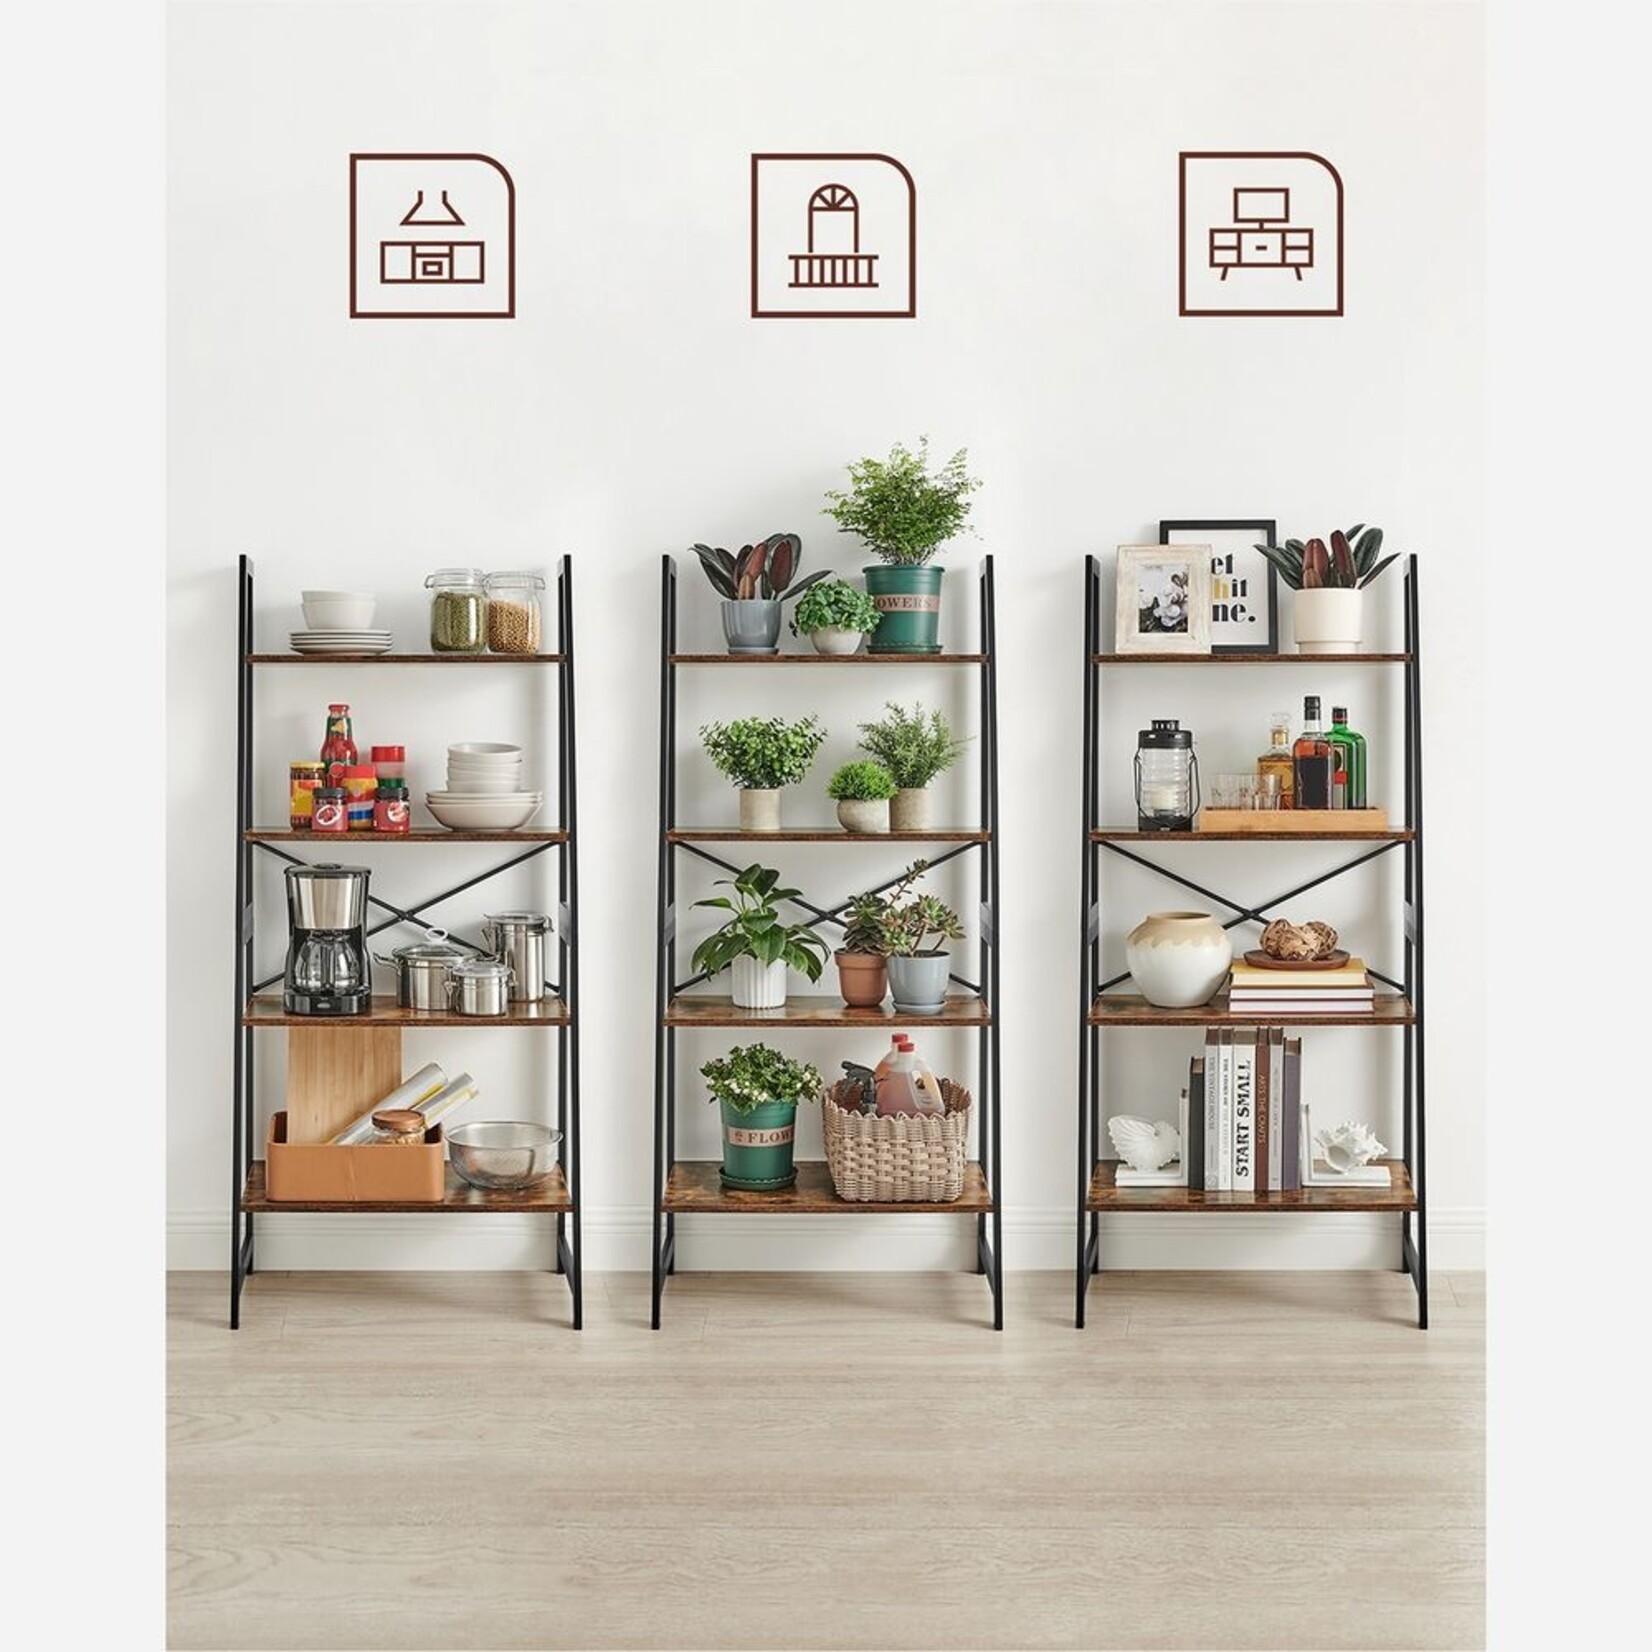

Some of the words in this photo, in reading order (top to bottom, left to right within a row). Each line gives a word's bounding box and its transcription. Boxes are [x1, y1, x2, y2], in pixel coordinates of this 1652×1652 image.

[1211, 553, 1233, 575] et
[1214, 578, 1247, 599] hit
[876, 597, 931, 609] OWERS
[1212, 603, 1256, 623] ne.
[1237, 1060, 1251, 1118] SMALL
[1236, 1123, 1250, 1177] START
